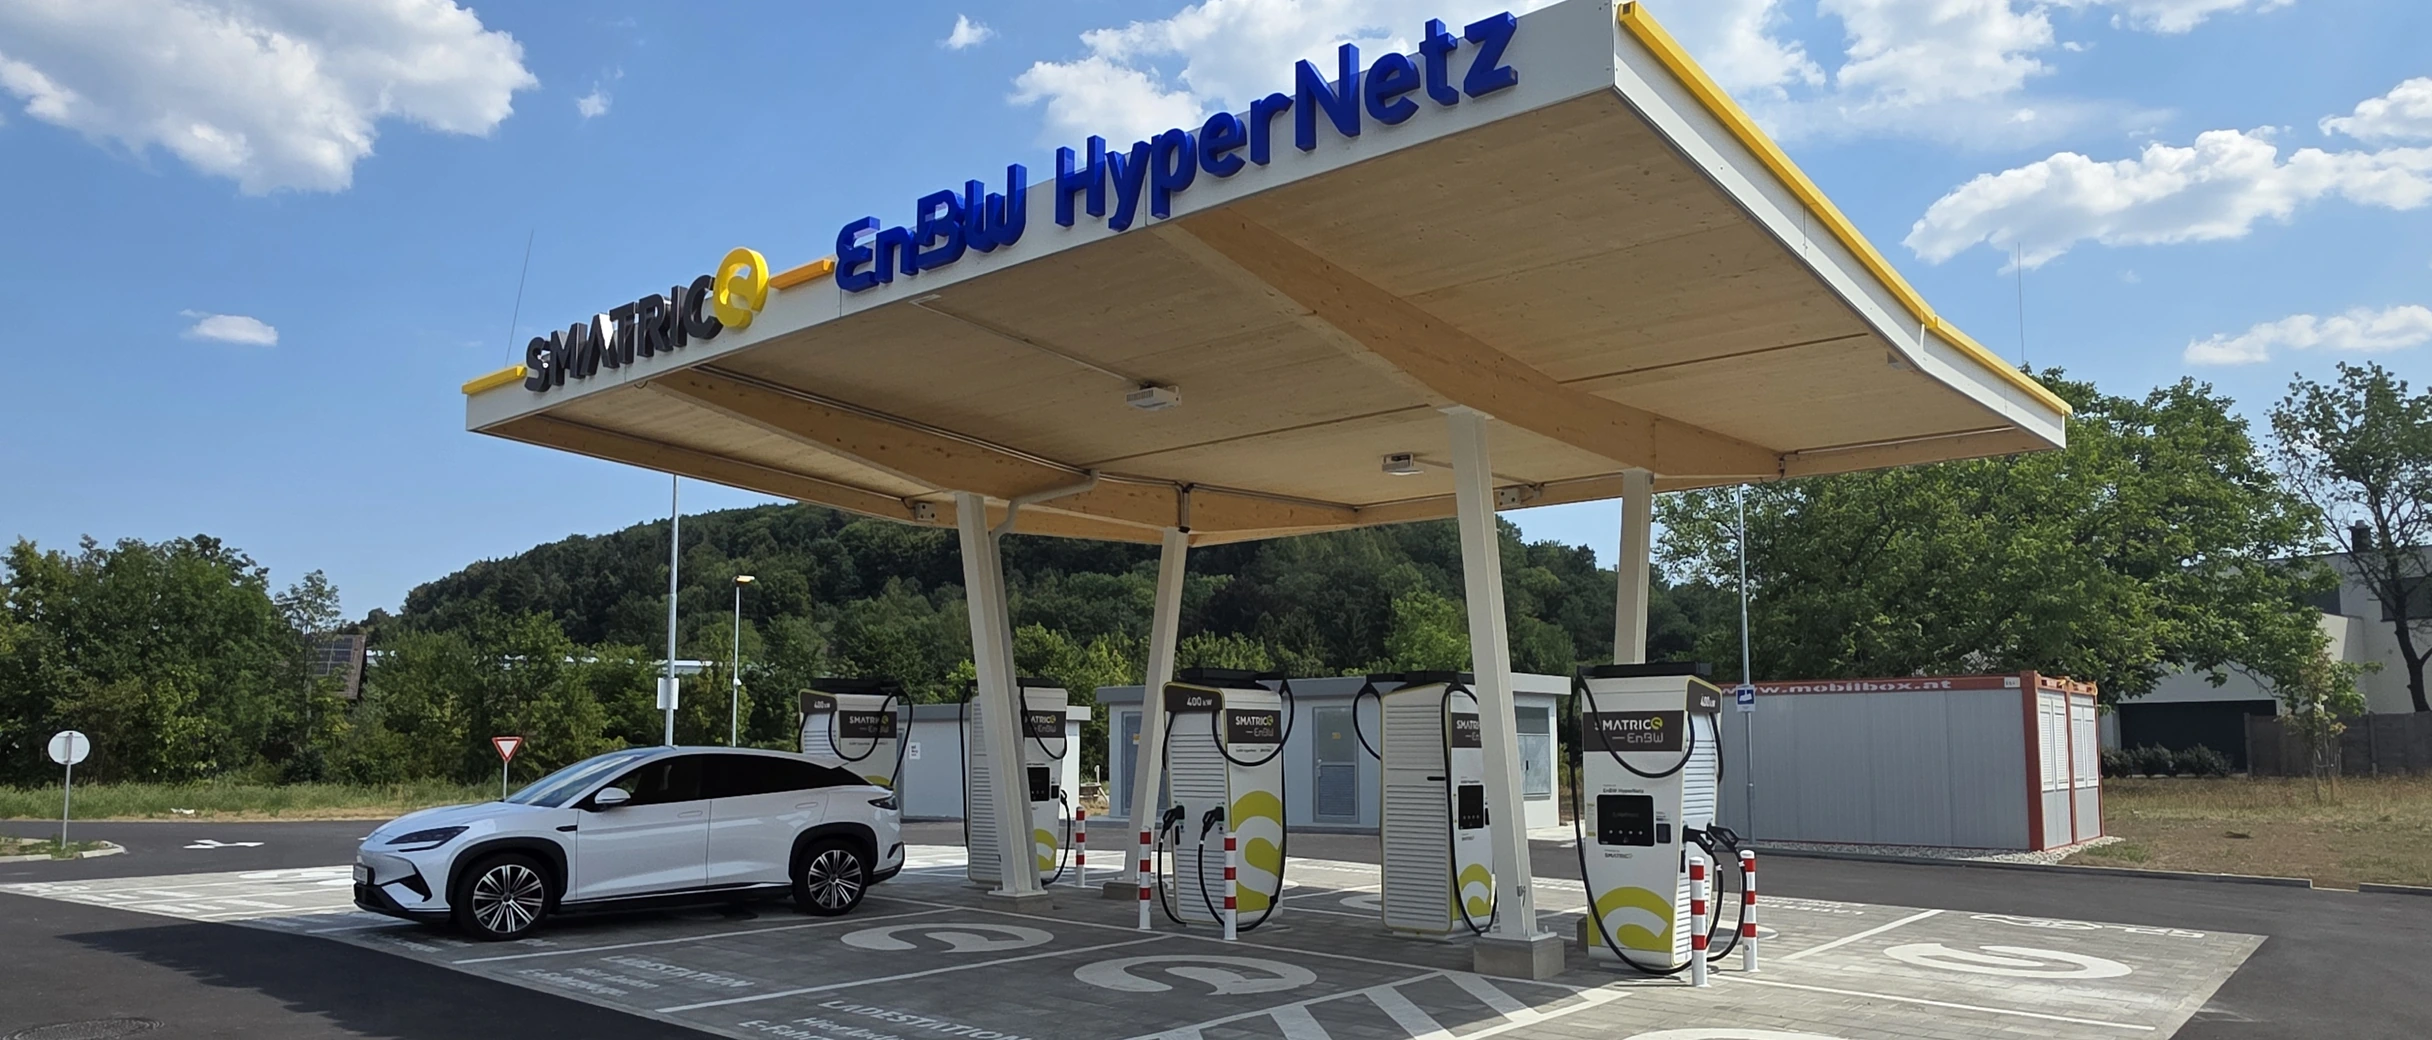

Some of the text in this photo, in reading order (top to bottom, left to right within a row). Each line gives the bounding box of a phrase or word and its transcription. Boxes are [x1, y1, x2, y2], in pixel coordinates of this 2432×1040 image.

[835, 11, 1519, 293] EnBW HyperNetz
[1722, 680, 1952, 694] ww.mobilbox.at
[1186, 696, 1202, 707] 400
[1626, 732, 1664, 744] EnBW
